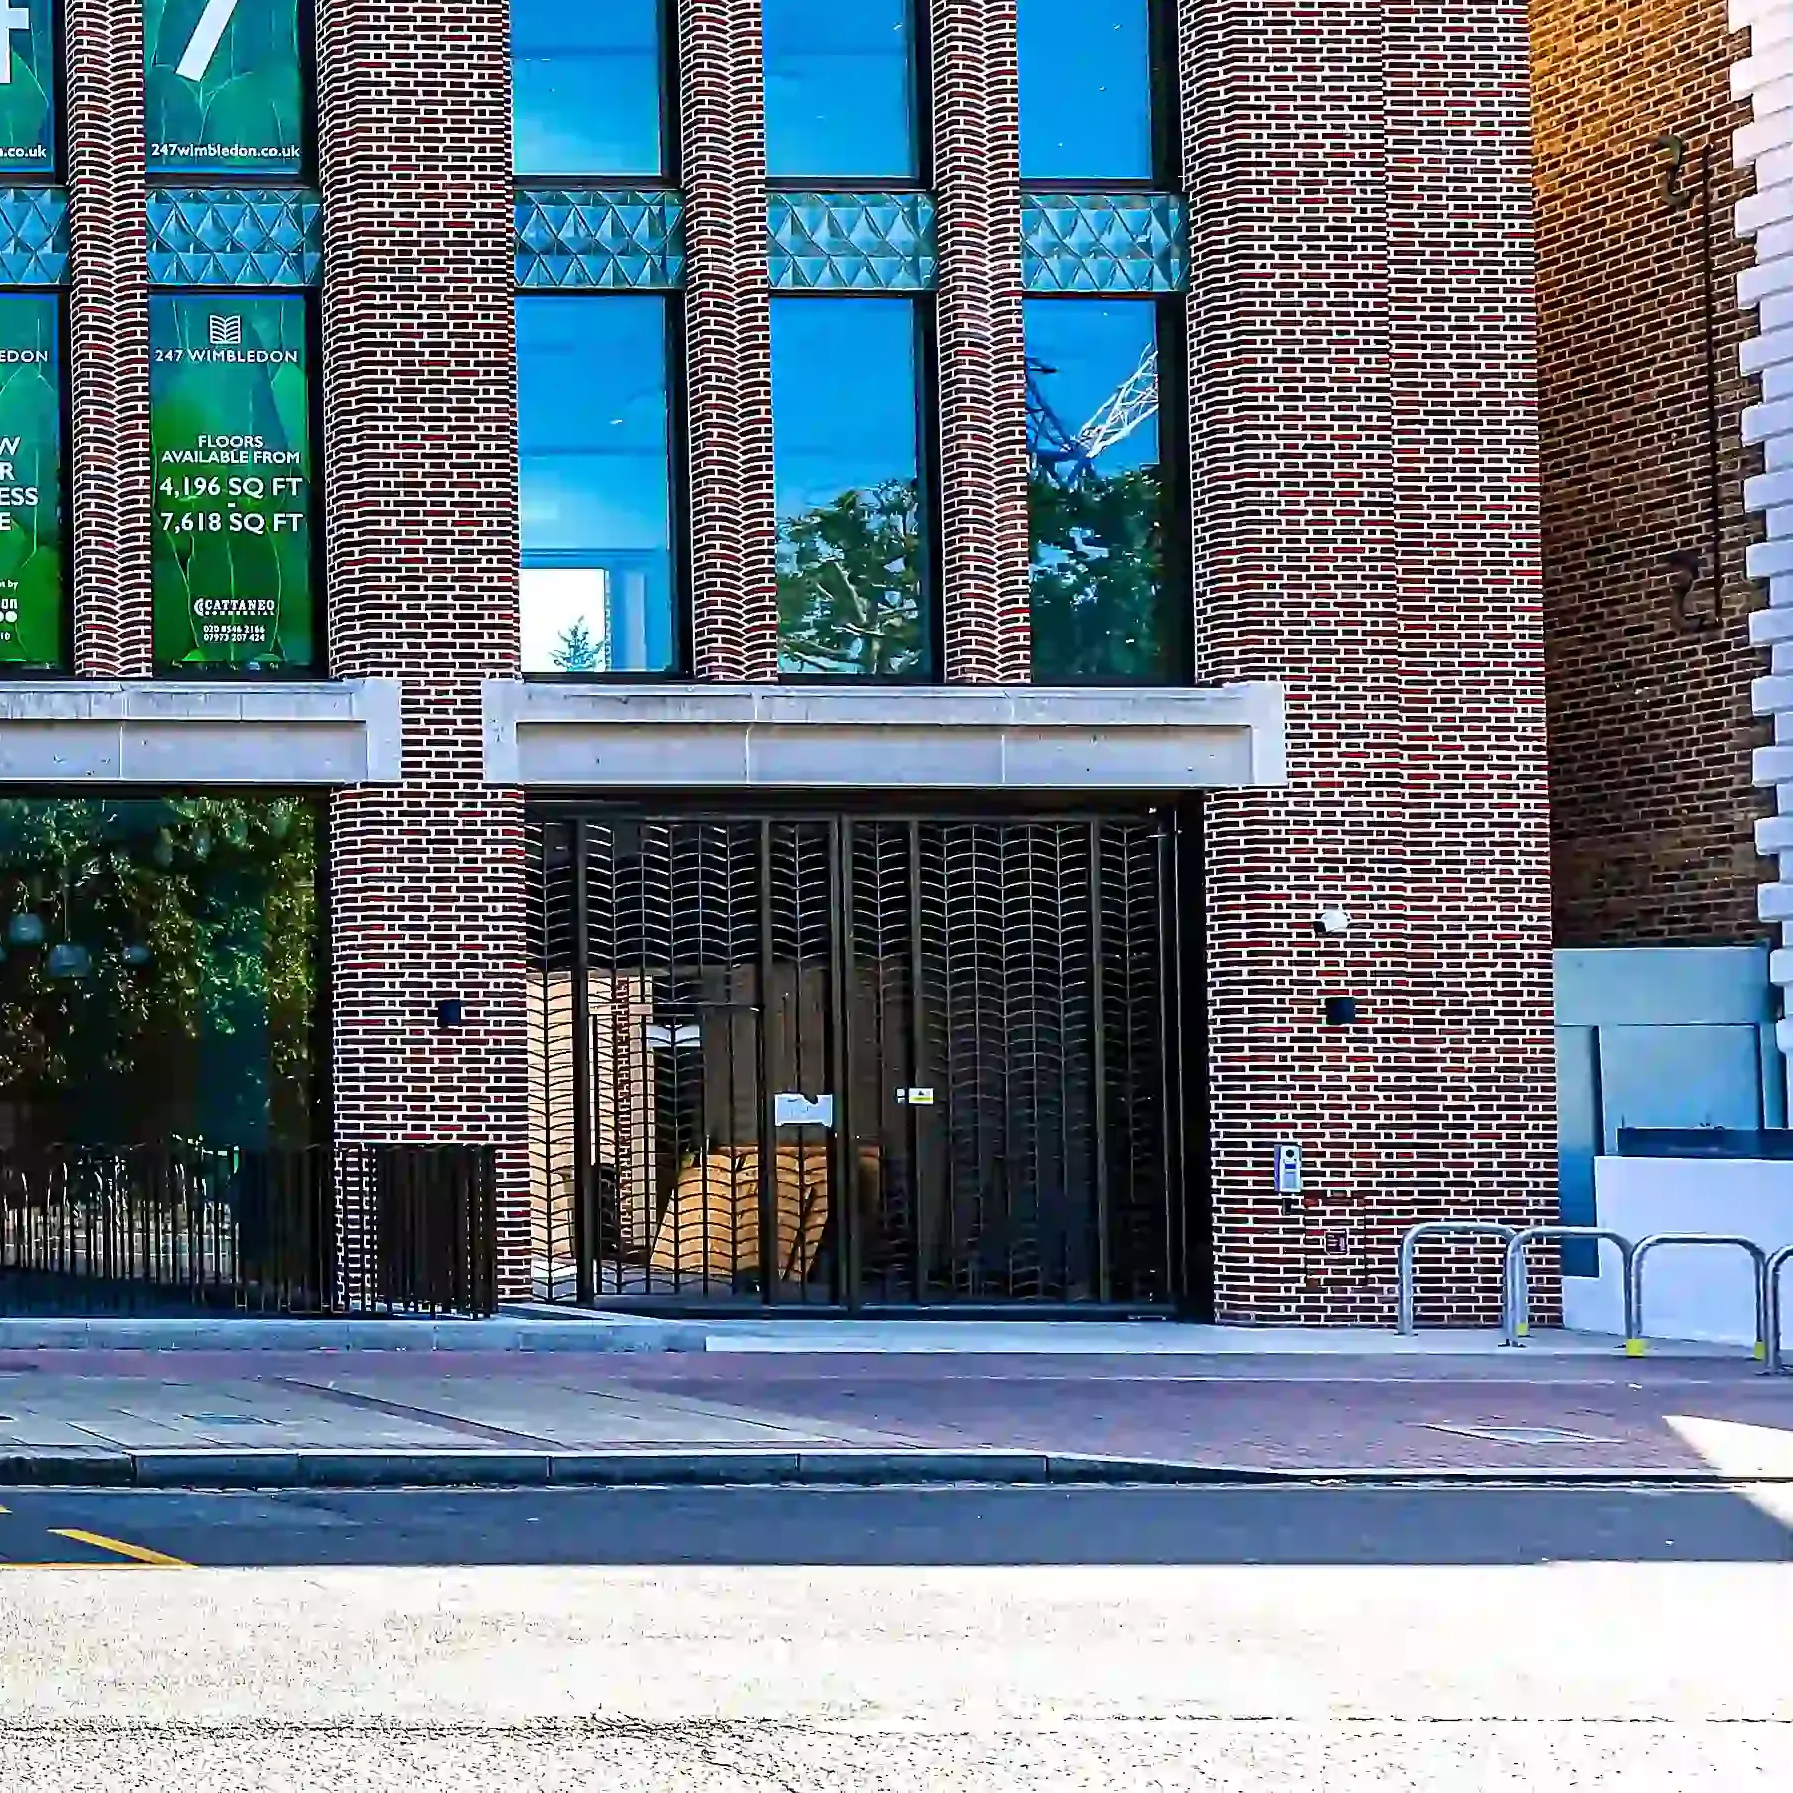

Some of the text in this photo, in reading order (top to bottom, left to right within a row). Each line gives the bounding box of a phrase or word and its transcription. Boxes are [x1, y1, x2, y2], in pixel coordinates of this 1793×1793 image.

[151, 142, 300, 157] 247wimbledon.co.uk
[155, 349, 297, 363] 247 WIMBLEDON
[198, 434, 264, 451] FLOORS
[161, 449, 300, 464] AVAILABLE FROM
[159, 476, 303, 500] 4,196 SQ FT
[160, 512, 304, 535] 7,618 SQ FT
[7, 579, 19, 591] by
[204, 599, 275, 610] CATTANEO
[203, 625, 219, 633] 020
[231, 634, 248, 642] 207
[249, 634, 266, 642] 424
